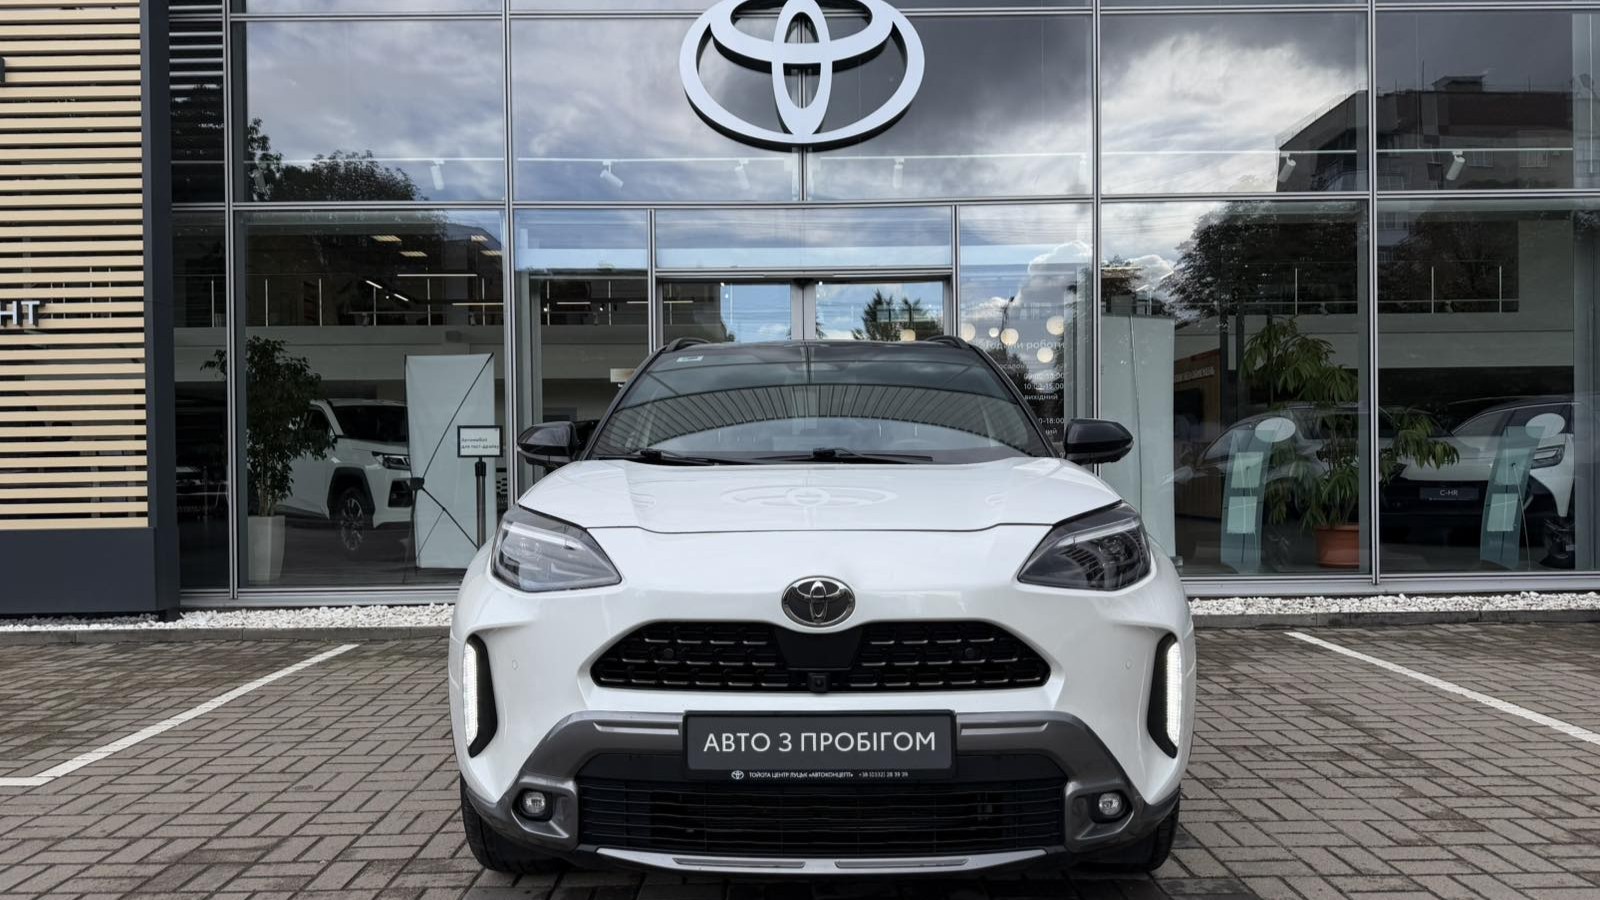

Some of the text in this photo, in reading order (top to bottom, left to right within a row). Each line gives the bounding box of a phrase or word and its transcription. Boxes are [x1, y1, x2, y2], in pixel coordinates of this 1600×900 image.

[1439, 489, 1459, 497] C-HR
[703, 732, 771, 752] АВТО
[800, 731, 936, 752] ПРОБІГОМ
